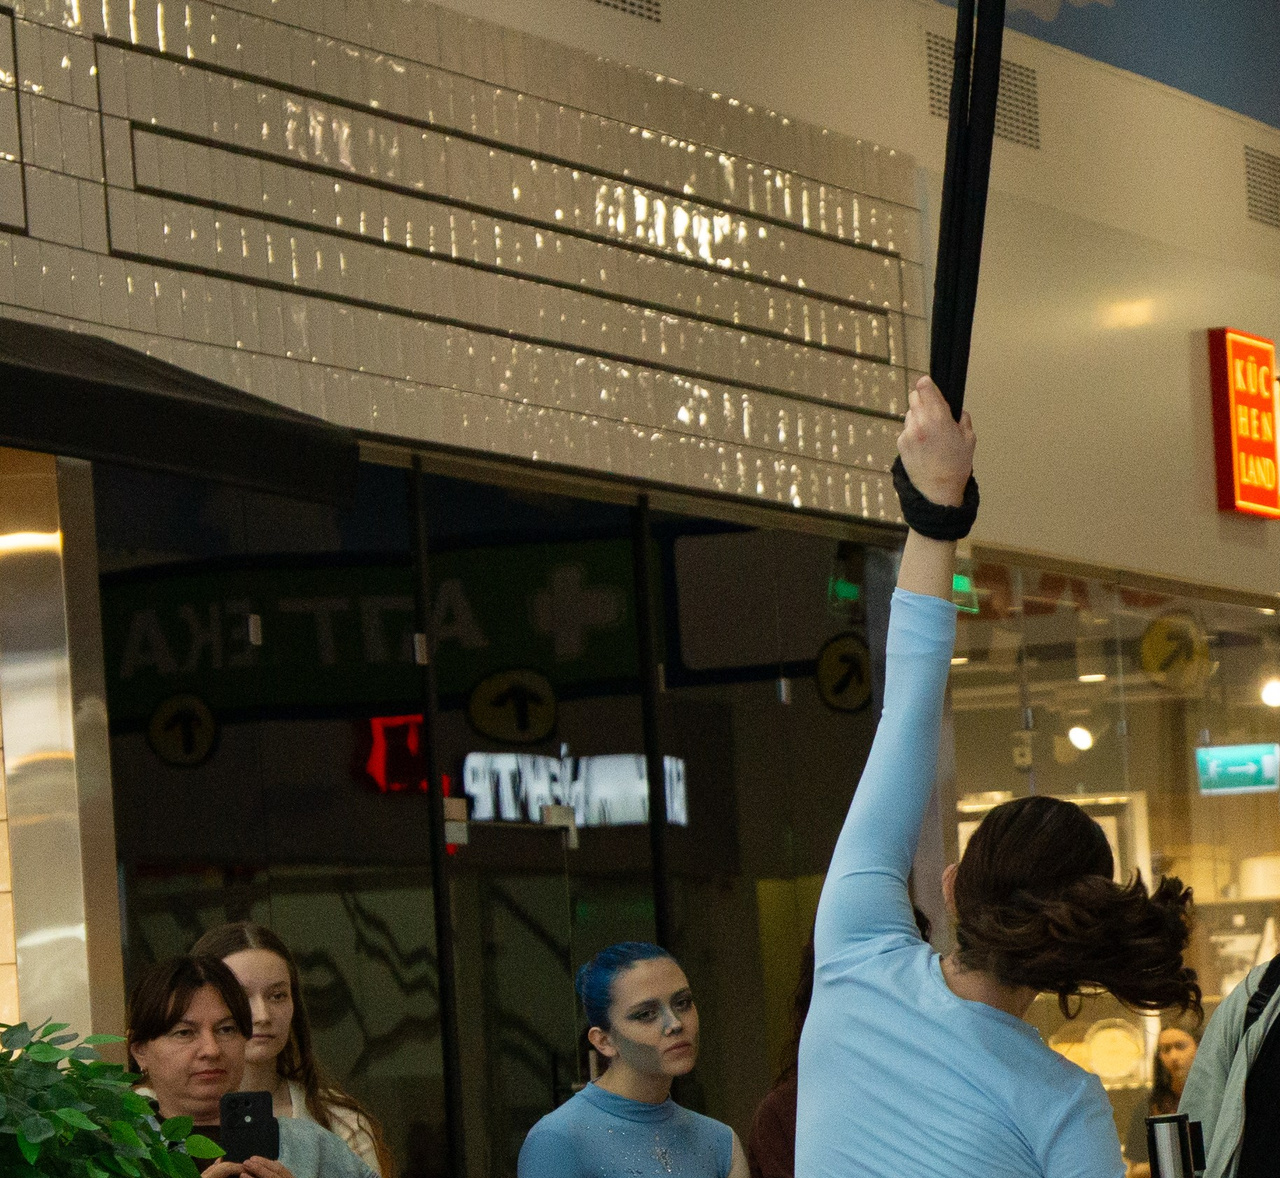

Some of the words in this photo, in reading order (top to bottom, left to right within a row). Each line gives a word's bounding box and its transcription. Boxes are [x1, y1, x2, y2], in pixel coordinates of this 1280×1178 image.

[1234, 355, 1270, 398] KÜC
[1237, 404, 1273, 442] HEN
[1239, 452, 1276, 491] LAND
